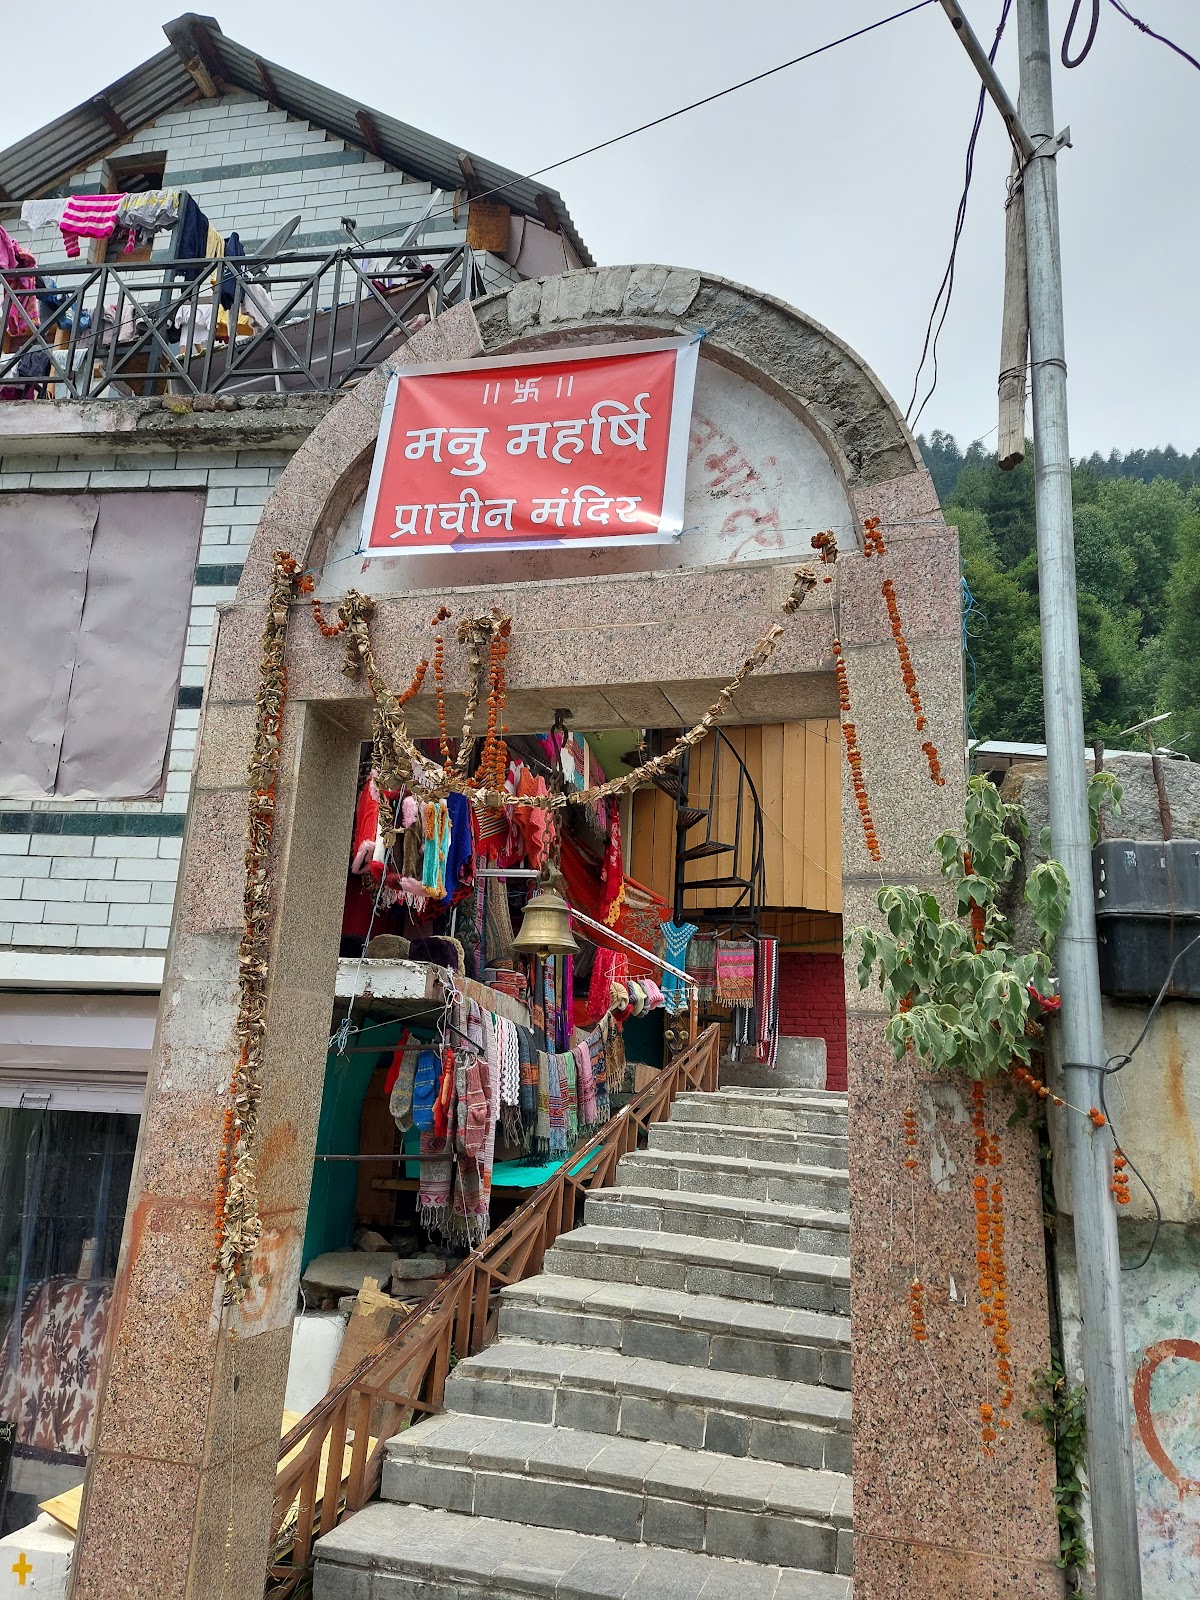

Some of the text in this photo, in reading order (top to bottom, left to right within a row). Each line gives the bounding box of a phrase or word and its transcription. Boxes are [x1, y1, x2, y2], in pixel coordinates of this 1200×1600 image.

[404, 427, 491, 477] मनु
[506, 392, 652, 464] महर्षि
[389, 485, 643, 539] प्राचीन मंदिर
